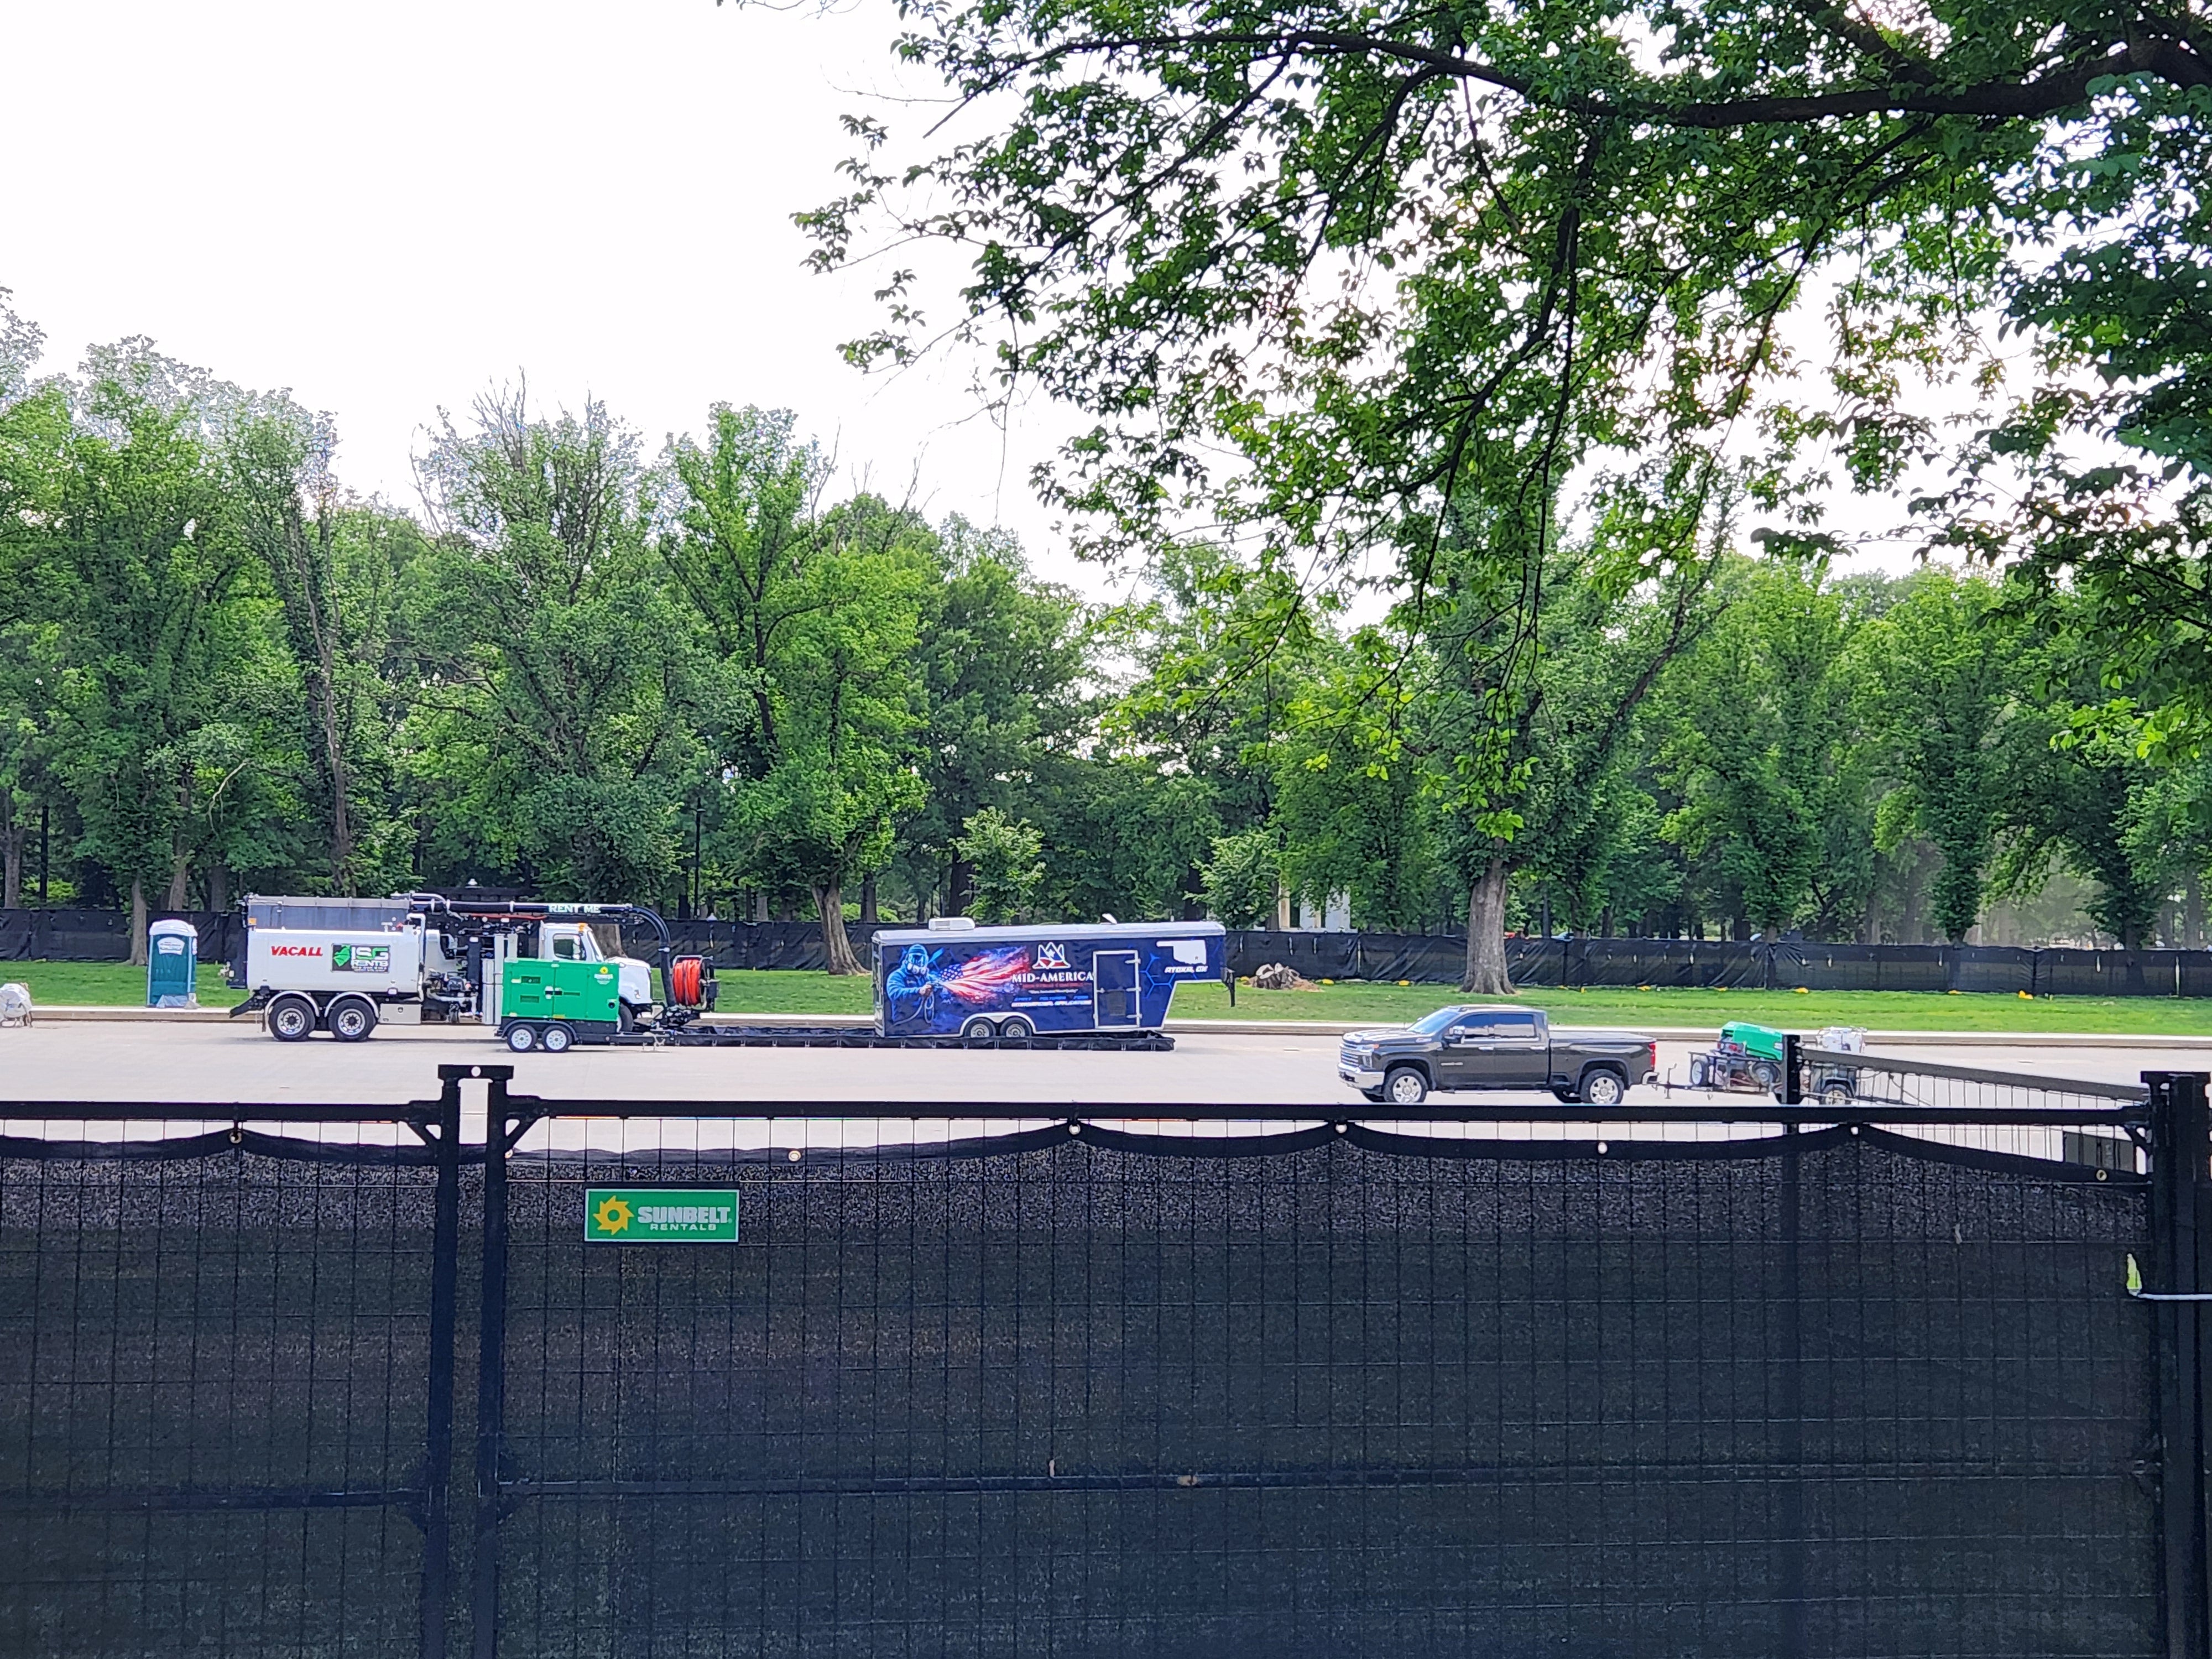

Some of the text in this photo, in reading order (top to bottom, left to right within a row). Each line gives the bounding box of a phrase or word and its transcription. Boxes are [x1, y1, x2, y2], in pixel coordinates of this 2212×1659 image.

[549, 904, 579, 913] RENT
[271, 946, 323, 957] VACALL
[351, 946, 389, 960] ISG
[1012, 971, 1094, 983] MID-AMERICA
[638, 1206, 731, 1224] SUNBELT
